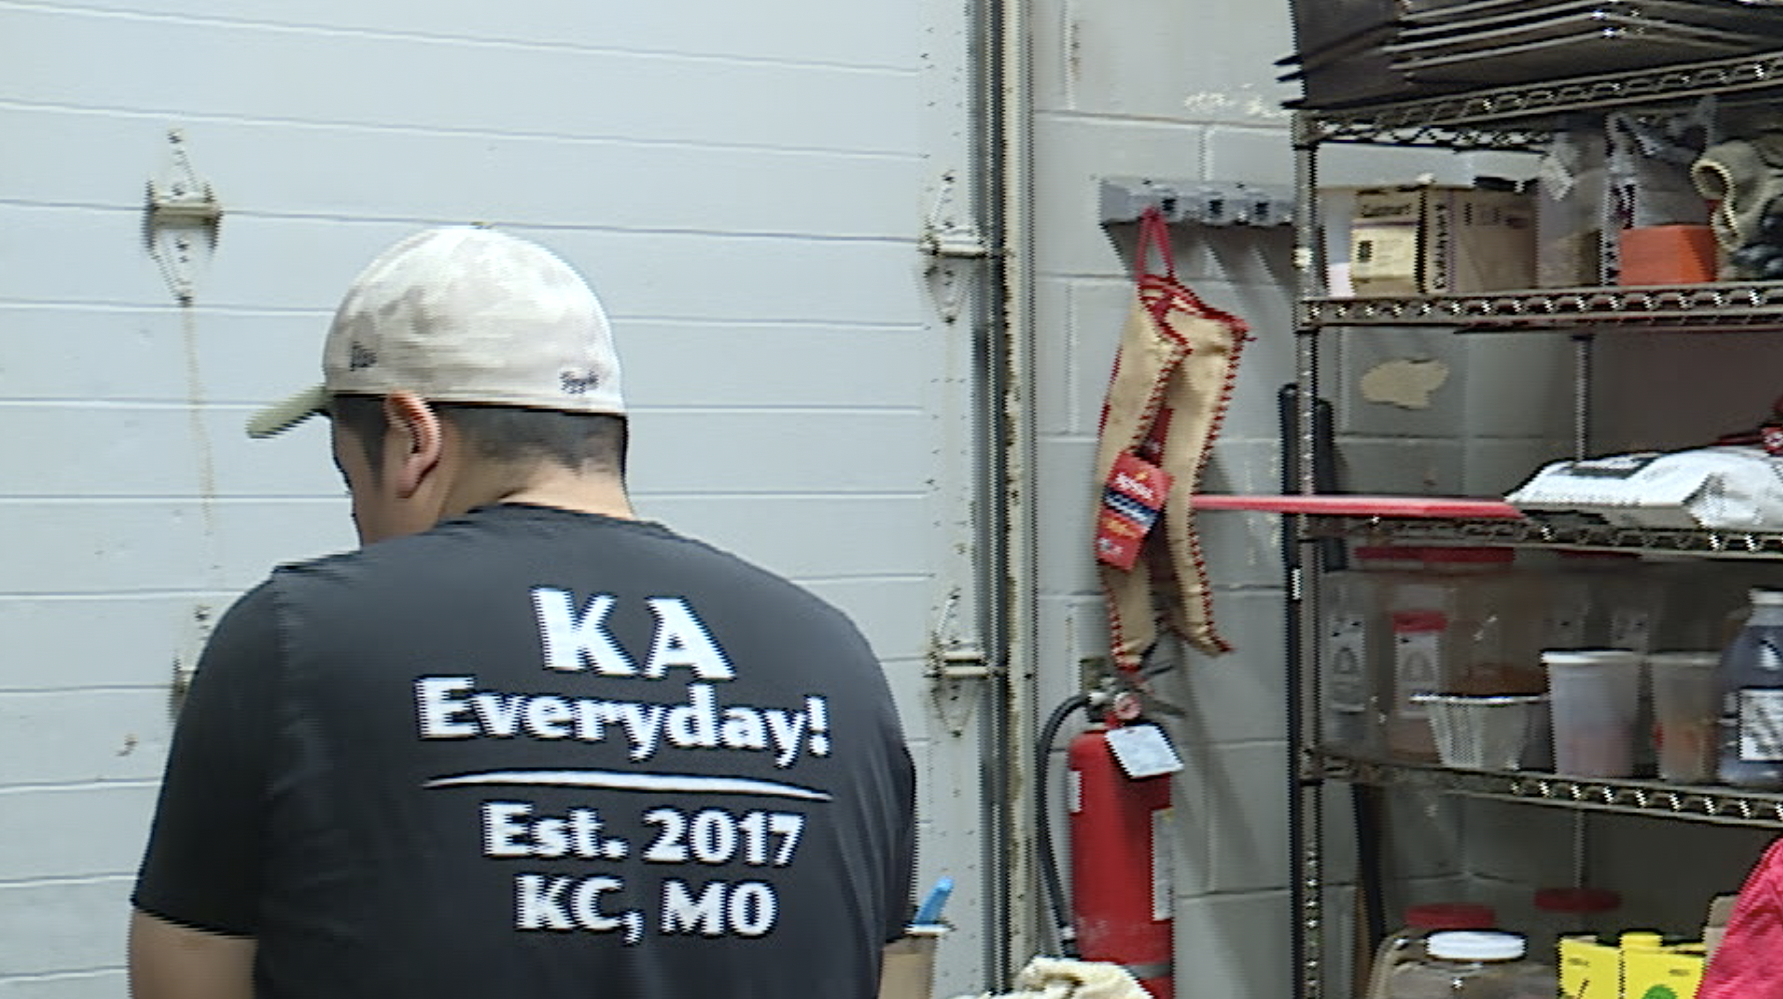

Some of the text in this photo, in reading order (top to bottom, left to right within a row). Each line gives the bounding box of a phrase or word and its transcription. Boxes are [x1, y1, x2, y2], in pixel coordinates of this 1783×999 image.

[414, 675, 831, 767] Everyday!
[482, 802, 804, 865] Est. 2017
[513, 874, 778, 944] KC, MO
